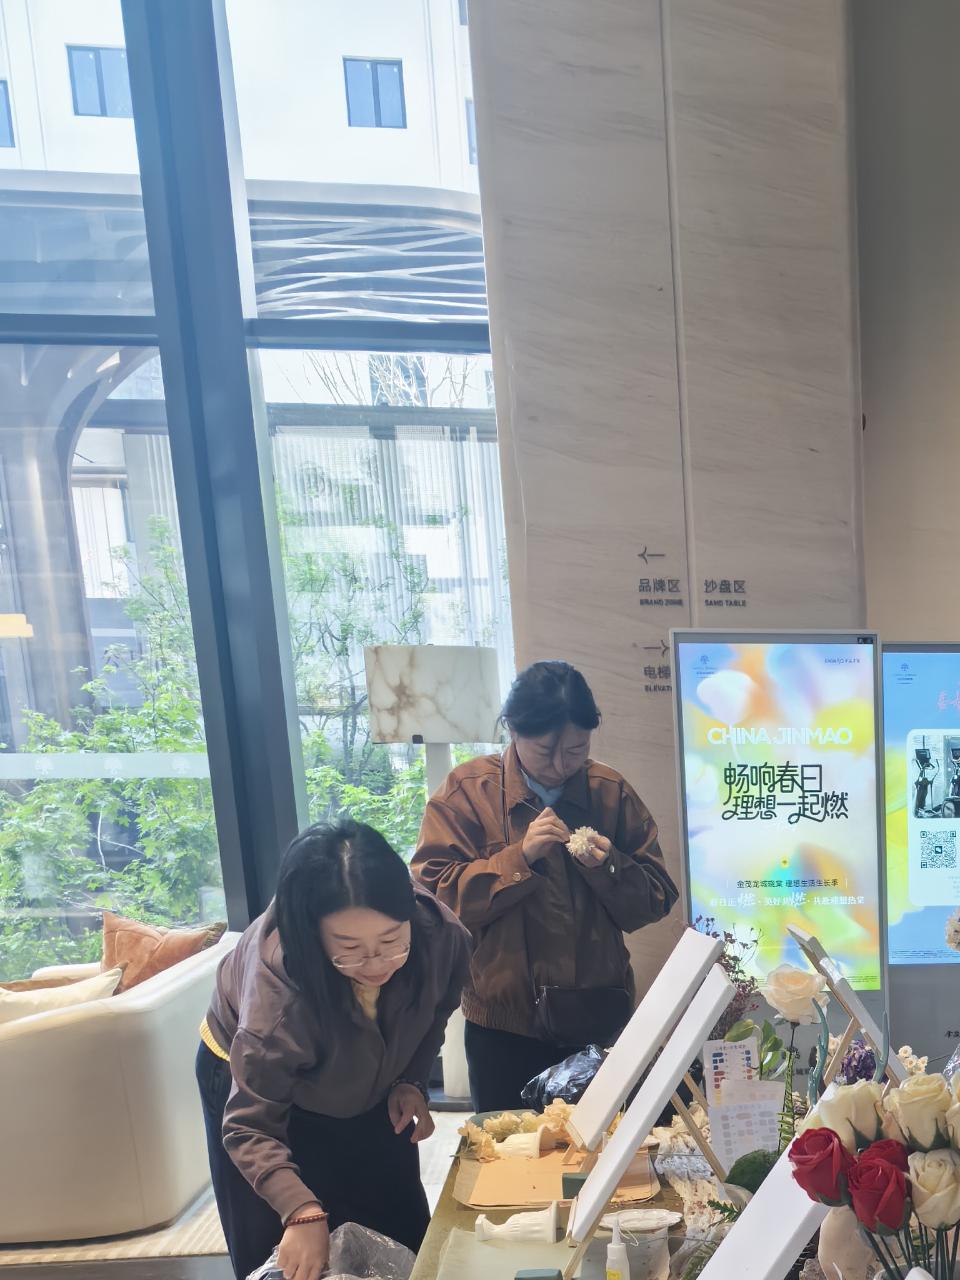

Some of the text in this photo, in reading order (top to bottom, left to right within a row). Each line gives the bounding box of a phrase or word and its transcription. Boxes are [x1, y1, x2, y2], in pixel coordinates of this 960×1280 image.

[638, 578, 681, 594] 品牌区
[704, 579, 746, 594] 沙盘区
[707, 727, 853, 745] CHINA JINMAO
[723, 761, 823, 802] 畅响春日
[721, 791, 849, 824] 理想一起燃
